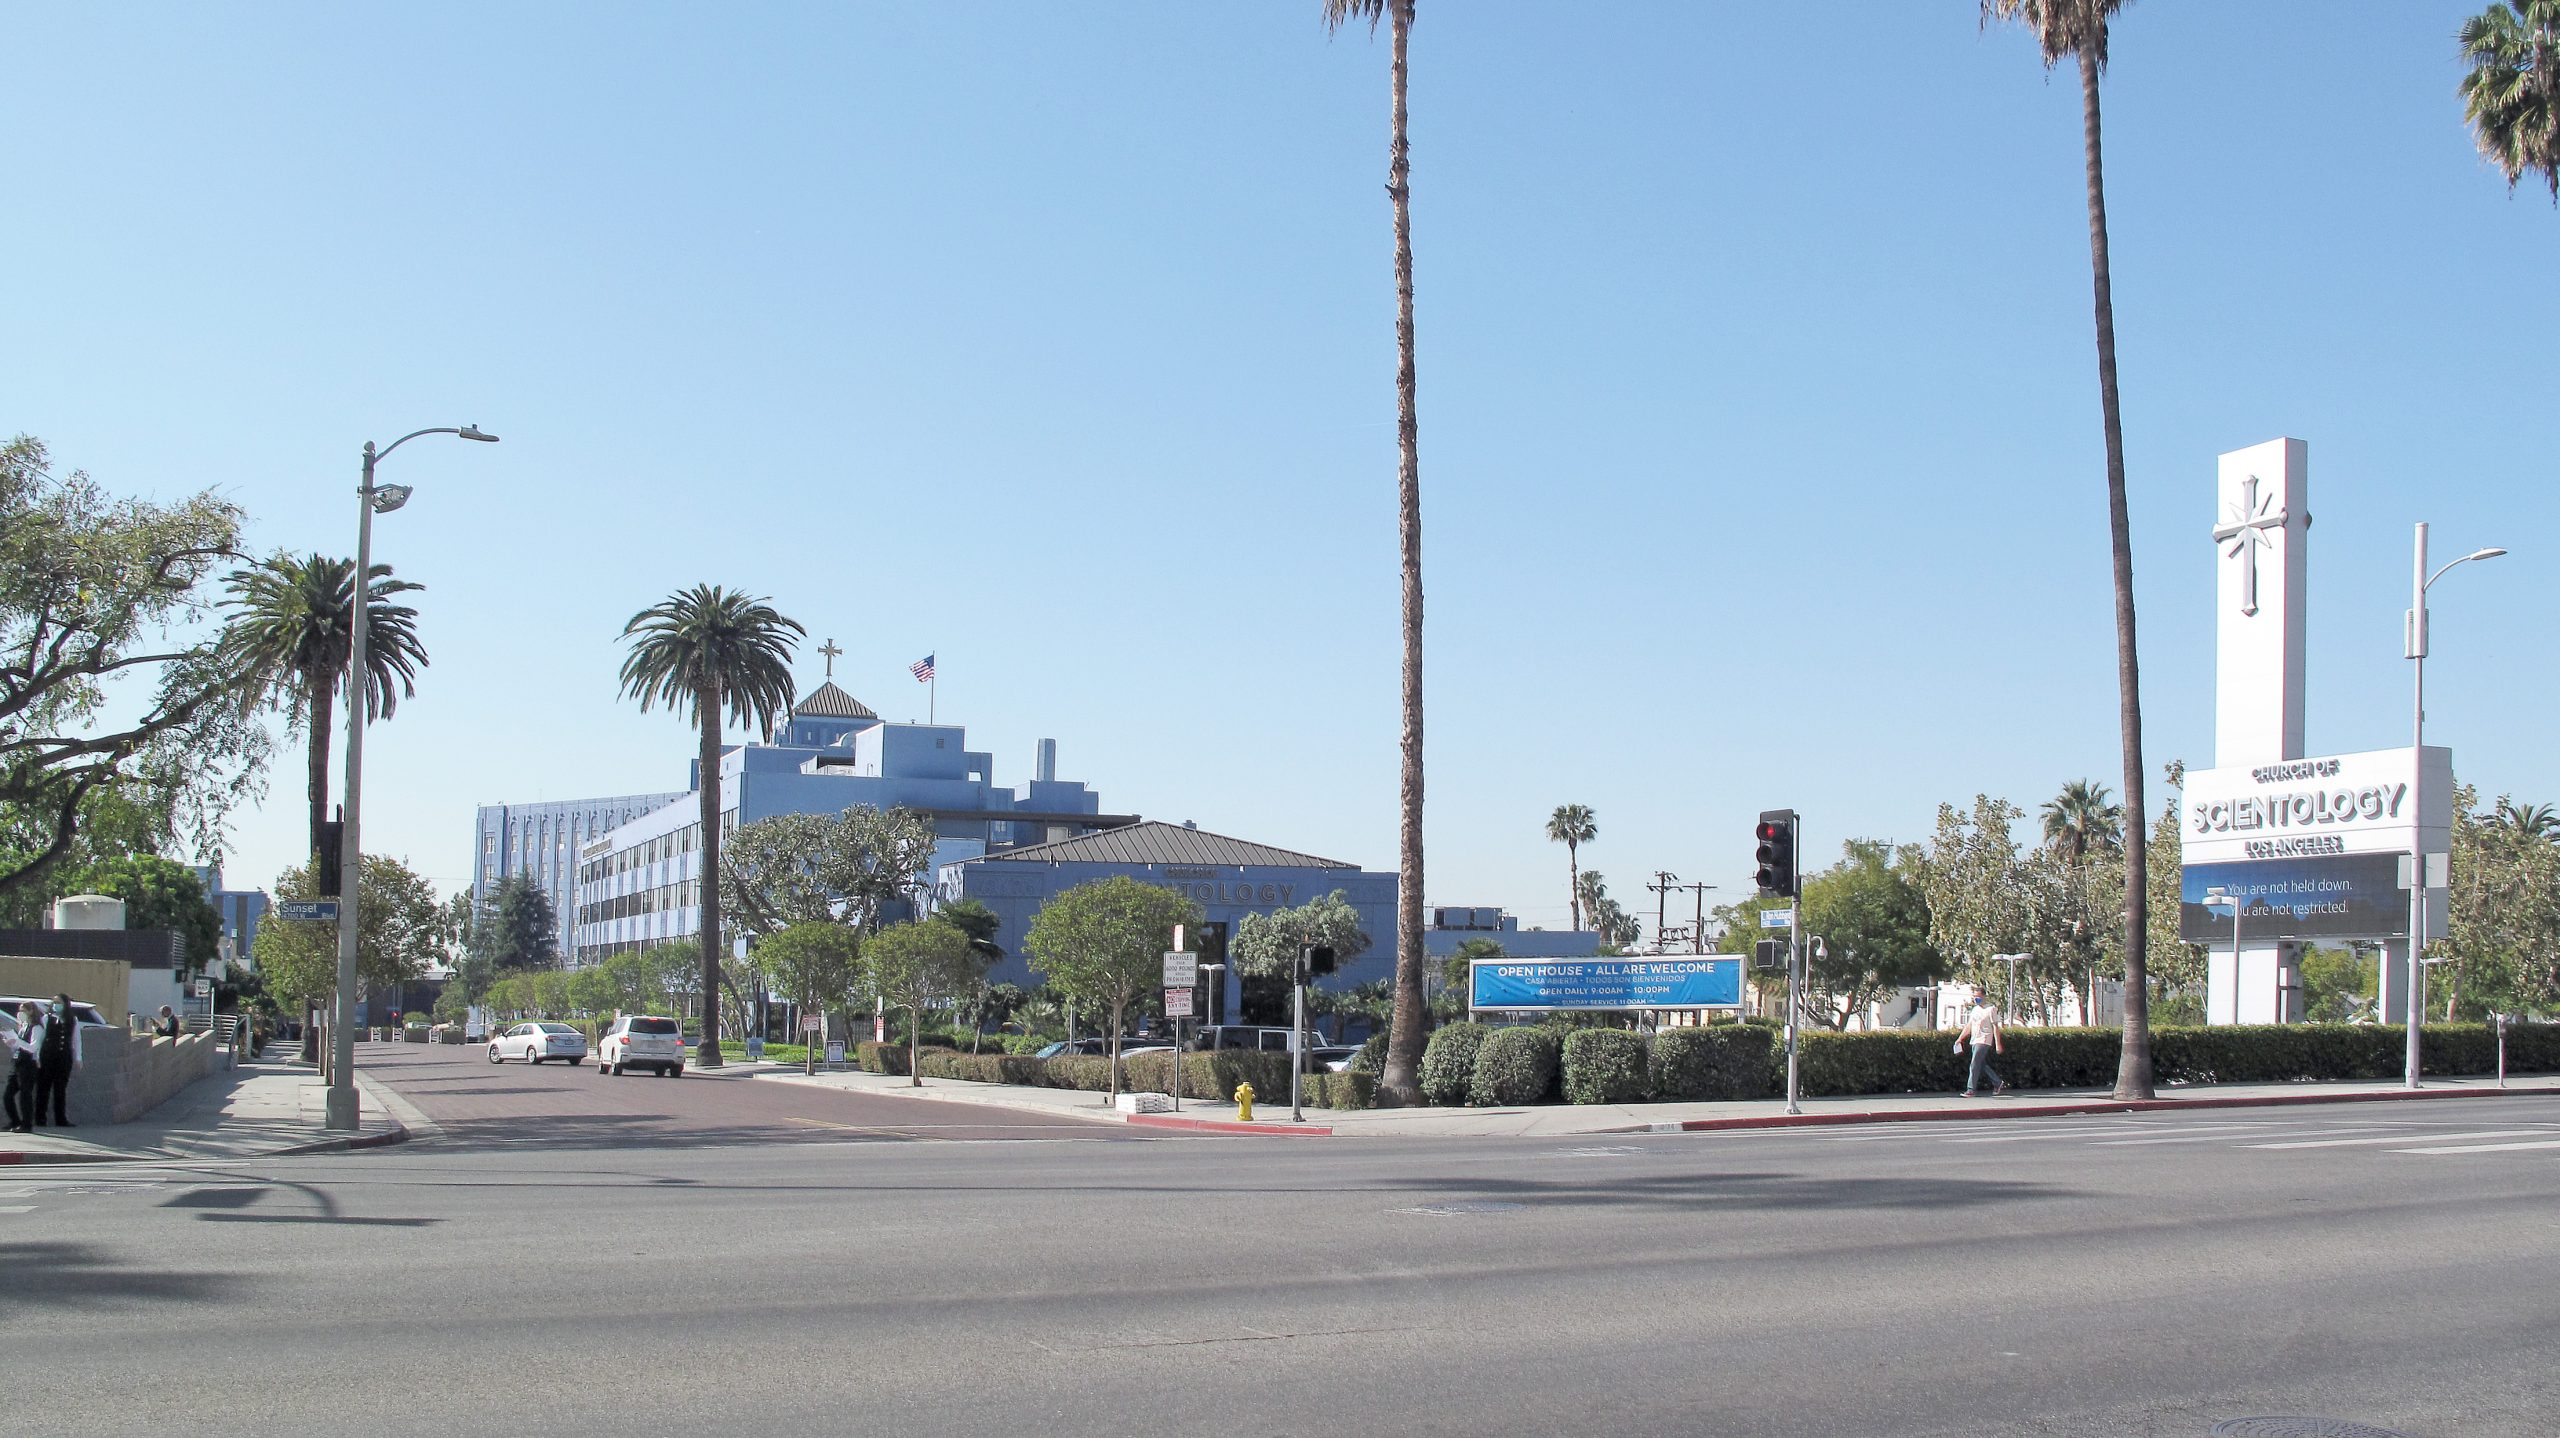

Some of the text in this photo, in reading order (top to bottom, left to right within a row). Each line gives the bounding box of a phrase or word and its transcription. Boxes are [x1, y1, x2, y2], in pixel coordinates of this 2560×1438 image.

[2252, 759, 2340, 783] CHURCH OF
[2193, 783, 2407, 833] SCIENTOLOGY
[2244, 835, 2344, 858] LOS ANGELES
[2227, 878, 2353, 896] You are not held down.
[282, 903, 318, 913] Sunset
[2252, 905, 2269, 916] are
[2271, 901, 2290, 915] not
[2293, 900, 2349, 914] restricted.
[1498, 962, 1715, 977] OPEN HOUSE ALL ARE WELCOME
[1586, 976, 1613, 984] TODOS
[1632, 975, 1686, 983] BIENVENIDOS
[1540, 987, 1563, 995] OPEN
[1564, 987, 1588, 995] DAILY
[1633, 985, 1671, 994] 10:00PM
